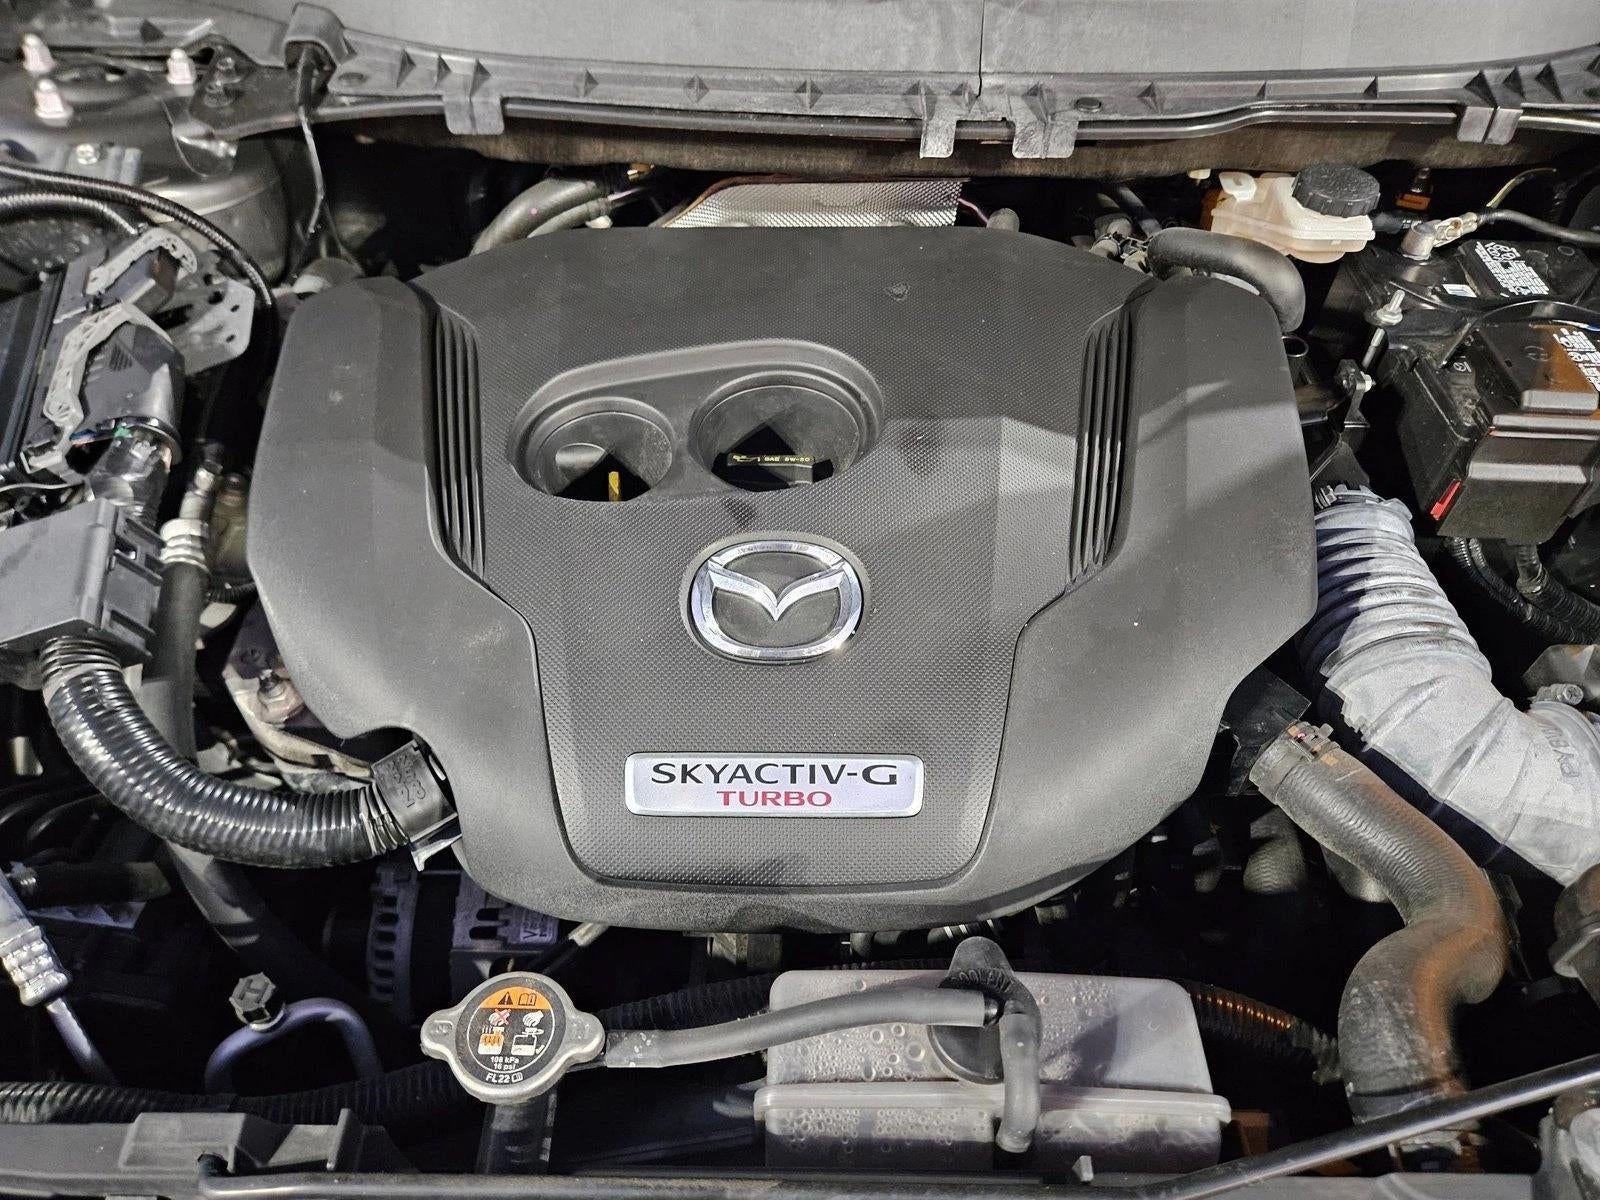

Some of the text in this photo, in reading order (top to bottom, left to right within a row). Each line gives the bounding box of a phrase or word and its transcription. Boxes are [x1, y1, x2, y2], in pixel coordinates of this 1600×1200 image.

[651, 762, 898, 786] SKYACTIV-G
[716, 790, 832, 807] TURBO
[504, 1056, 519, 1064] kPa
[485, 1072, 511, 1083] FL22
